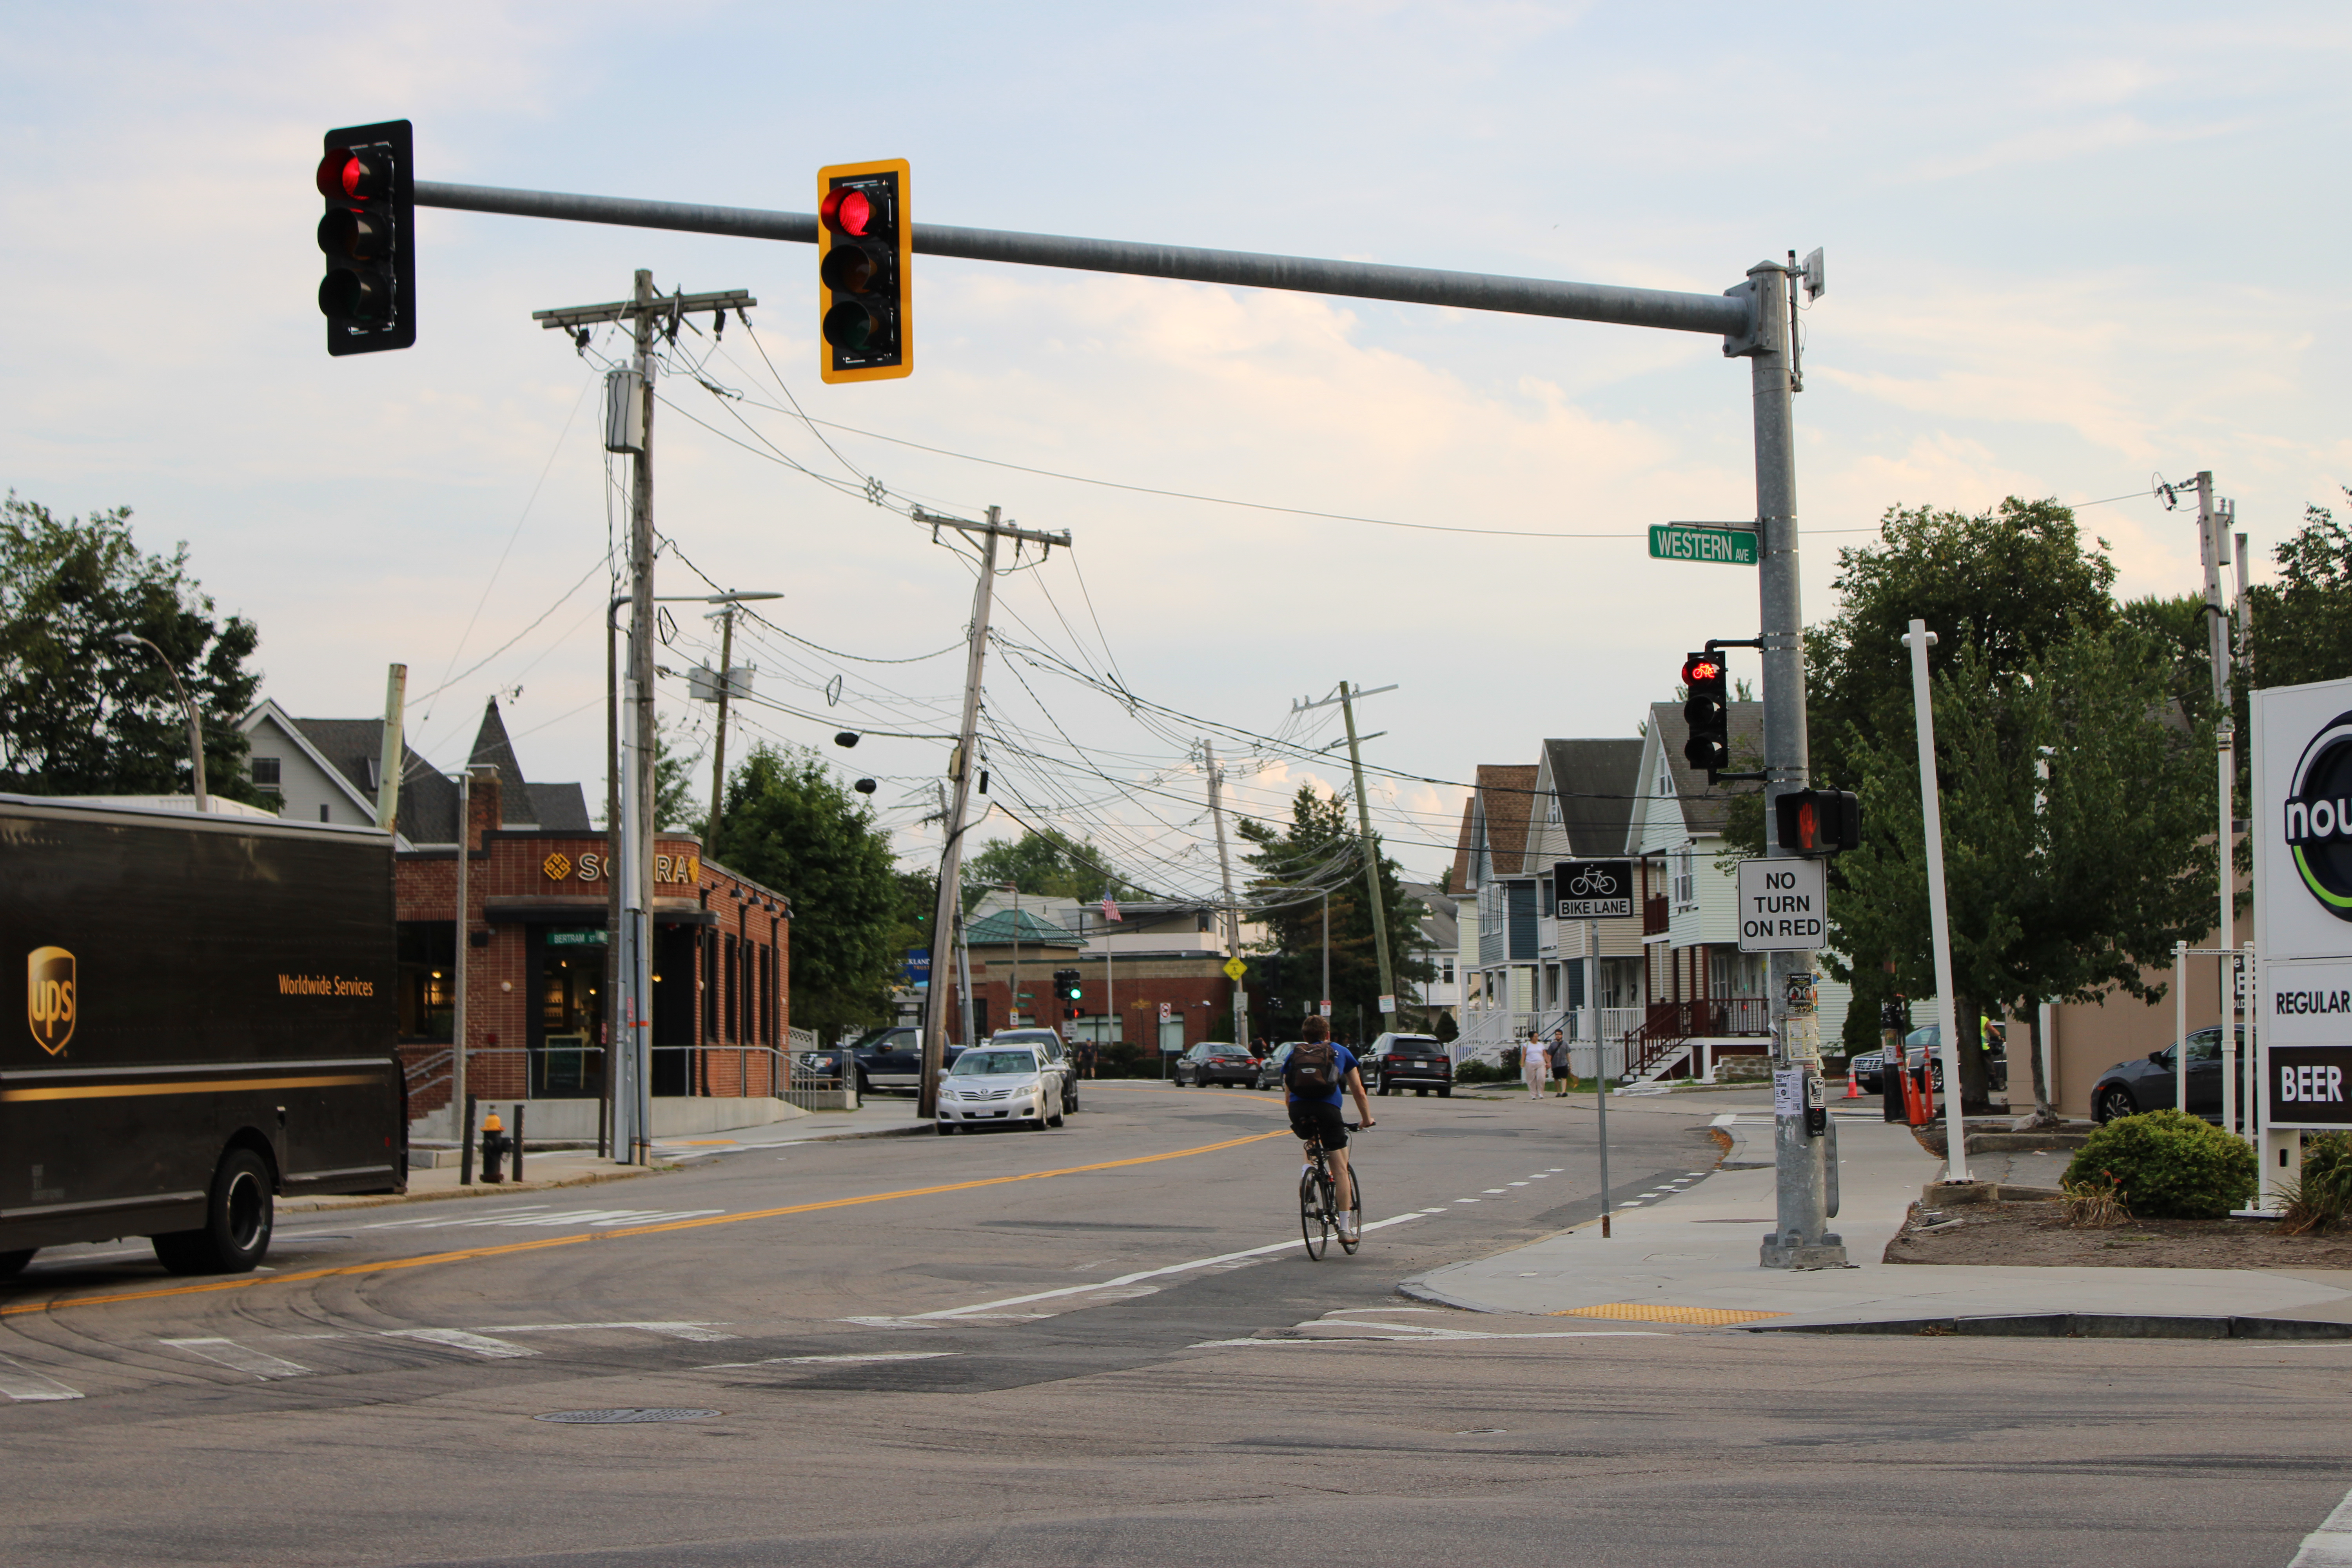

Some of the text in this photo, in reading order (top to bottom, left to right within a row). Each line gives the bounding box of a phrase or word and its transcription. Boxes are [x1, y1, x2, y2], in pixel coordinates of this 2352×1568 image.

[1657, 530, 1749, 561] WESTERN AVE
[2287, 798, 2352, 839] nou
[578, 852, 688, 883] SRA
[1766, 872, 1796, 889] NO
[1562, 900, 1627, 915] BIKE LANE
[1753, 895, 1810, 913] TURN
[554, 933, 585, 944] BERTRAM
[1744, 918, 1821, 938] ON RED
[279, 974, 373, 996] Worldwide Services
[32, 980, 73, 1038] ups
[2276, 990, 2350, 1014] REGULAR
[2281, 1065, 2343, 1102] BEER
